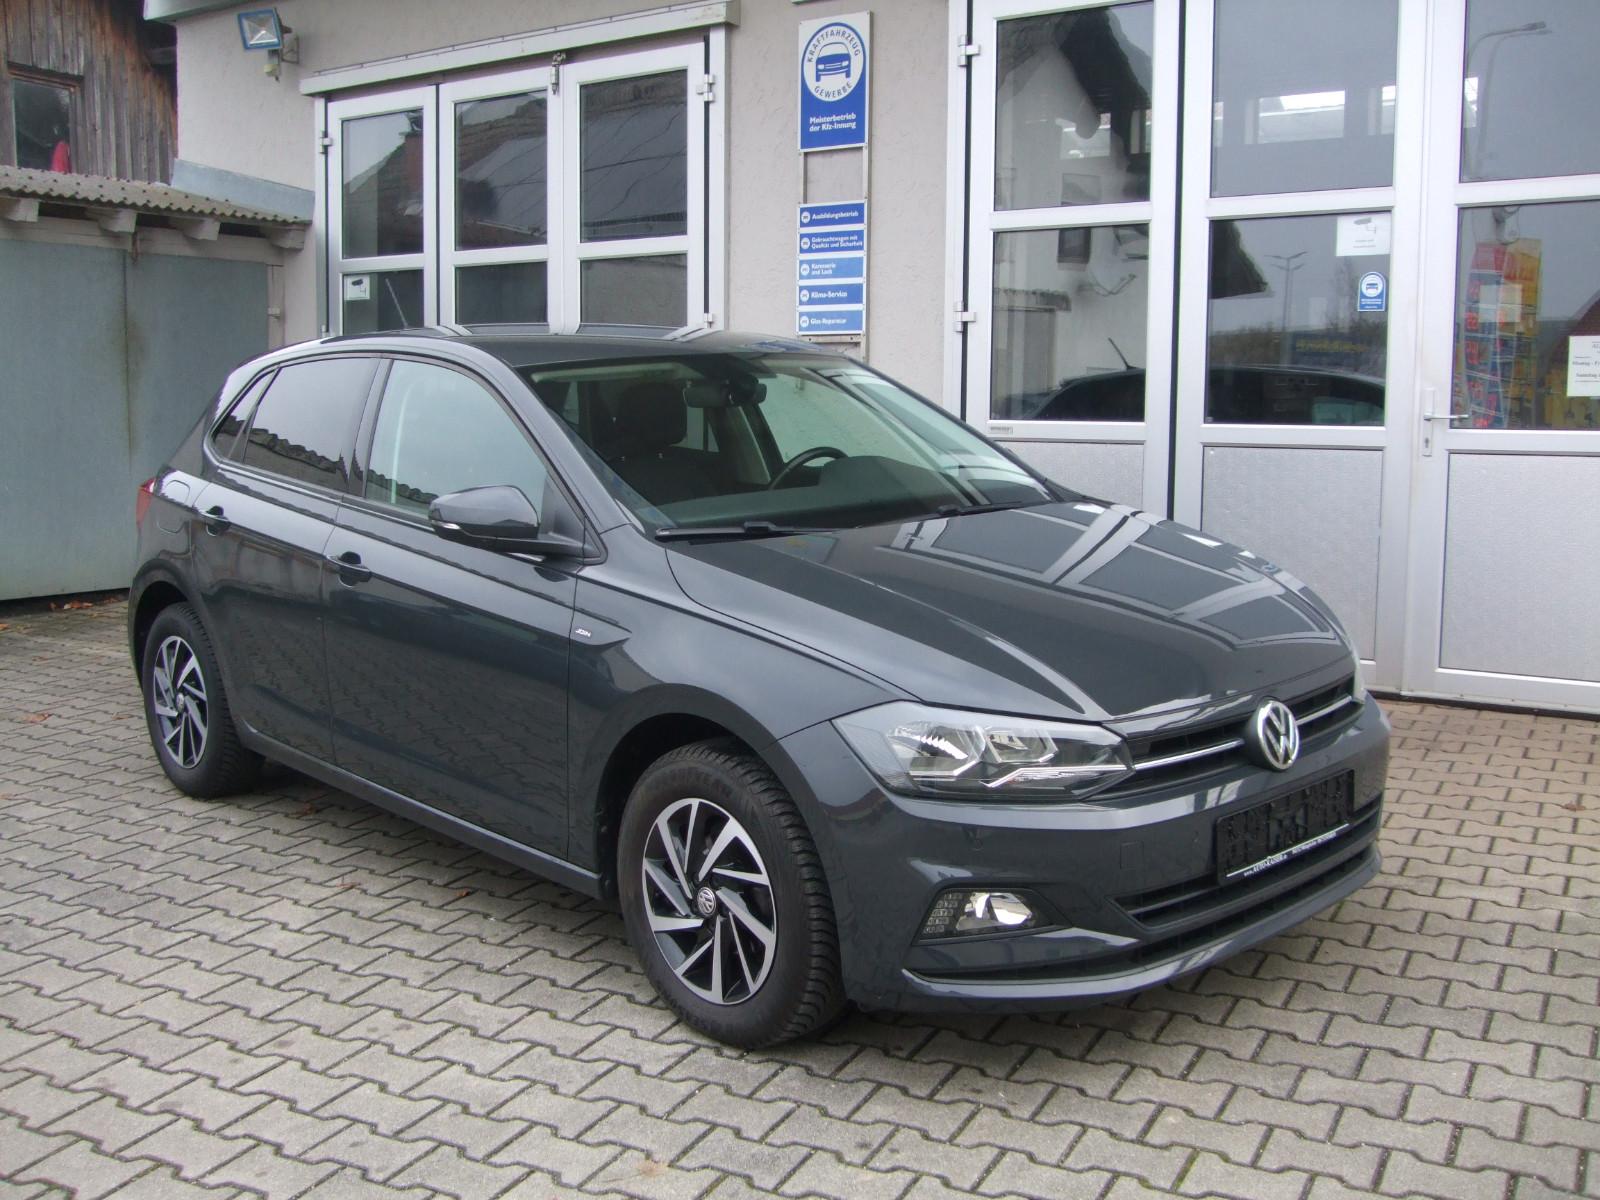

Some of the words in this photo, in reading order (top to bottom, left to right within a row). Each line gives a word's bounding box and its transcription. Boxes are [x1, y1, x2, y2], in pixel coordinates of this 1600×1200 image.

[806, 27, 861, 63] KRAFTFAHRZEUG
[814, 82, 852, 98] GEWERBE
[809, 112, 857, 124] Meisterbetrieb
[809, 124, 820, 132] der
[821, 121, 857, 131] Kfz-Innung
[811, 210, 859, 220] Ausbildungsbetrieb
